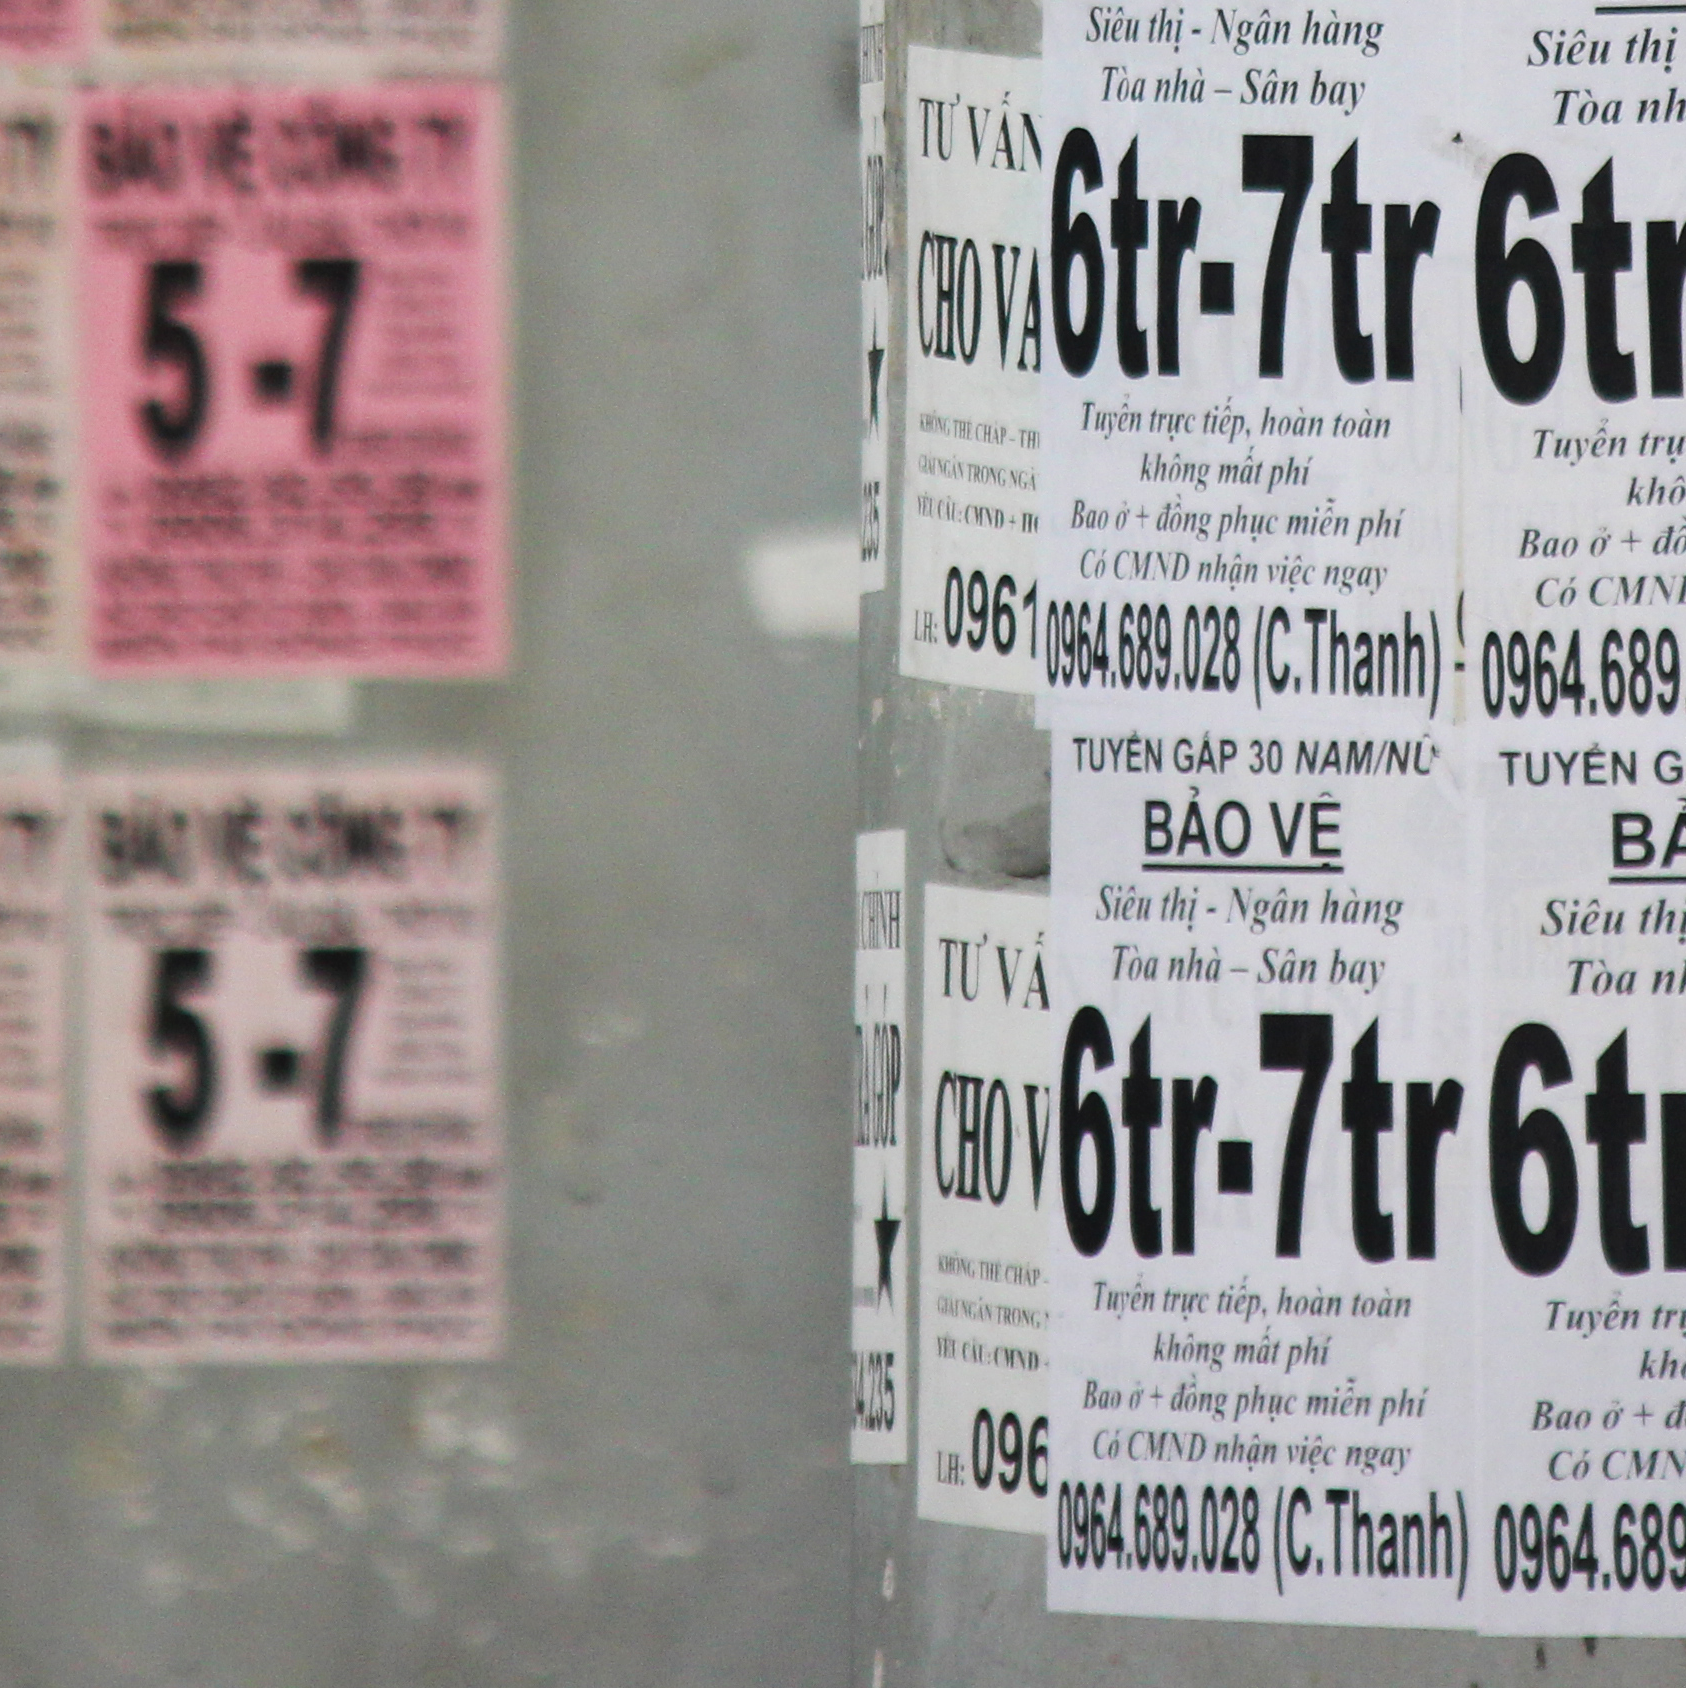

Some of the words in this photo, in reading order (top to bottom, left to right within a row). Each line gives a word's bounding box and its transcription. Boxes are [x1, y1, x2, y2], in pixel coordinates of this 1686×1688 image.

[919, 93, 961, 161] TƯ
[918, 229, 981, 365] CHO
[1051, 127, 1442, 386] 6tr-7tr
[944, 565, 1037, 659] 0961
[1045, 599, 1241, 693] 0964.689.028
[1253, 605, 1441, 720] (C.Thanh)
[1072, 730, 1163, 773] TUYỂN
[1172, 730, 1238, 774] GẤP
[1248, 739, 1283, 775] 30
[1498, 742, 1637, 787] TUYỂN
[1144, 785, 1252, 858] BẢO
[1268, 791, 1342, 865] VỆ
[939, 932, 988, 1001] TƯ
[935, 1070, 1012, 1206] CHO
[1059, 1004, 1465, 1264] 6tr-7tr
[972, 1407, 1048, 1499] 096
[1057, 1480, 1261, 1575] 0964.689.028
[1273, 1485, 1469, 1601] (C.Thanh)
